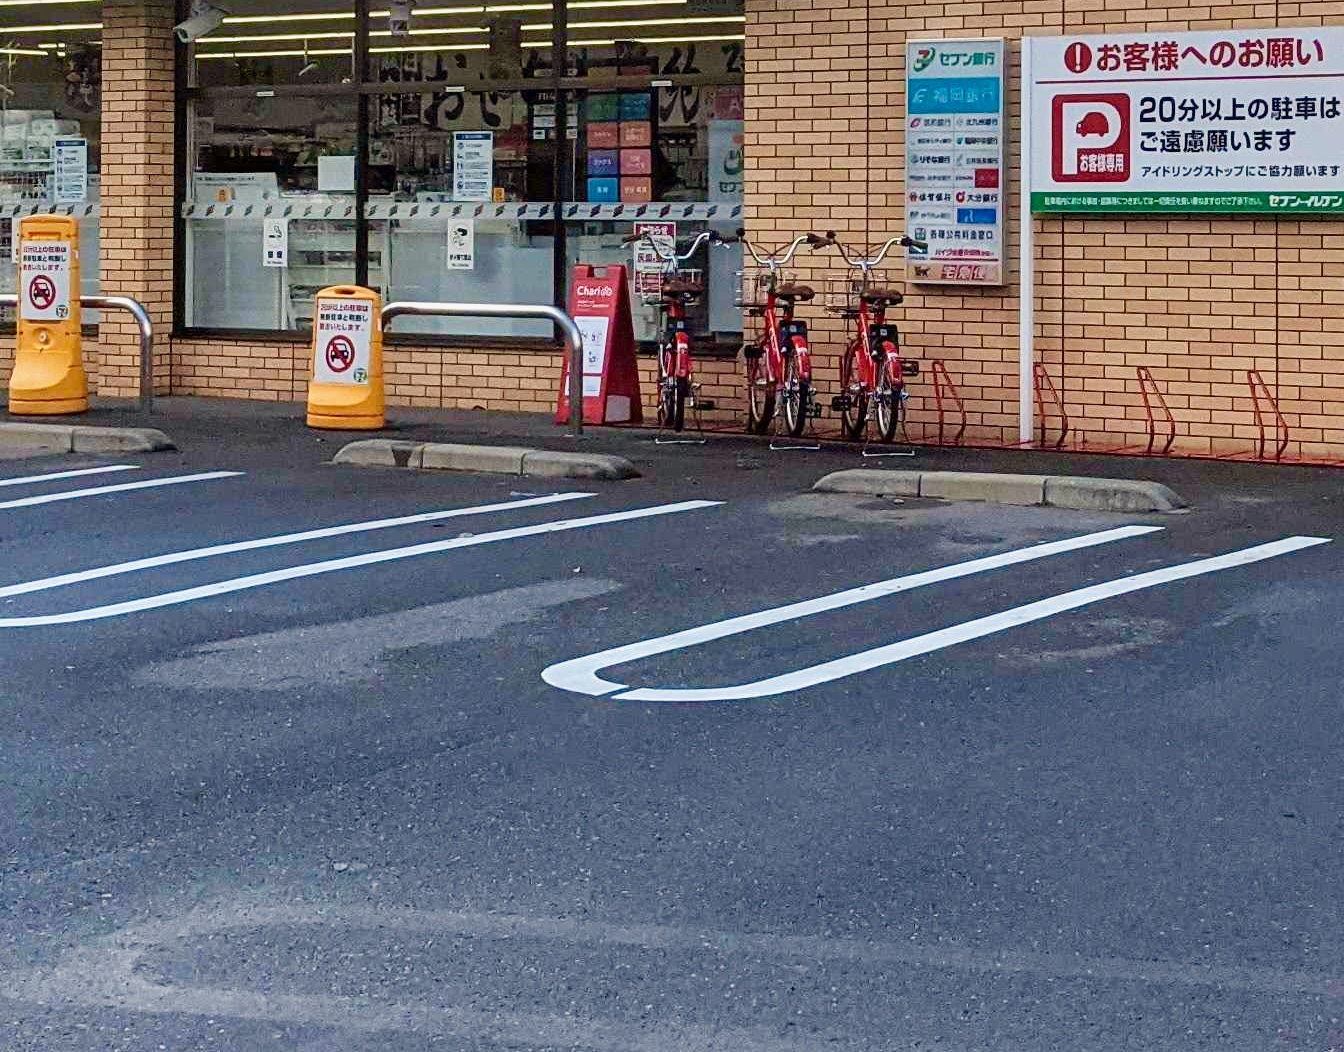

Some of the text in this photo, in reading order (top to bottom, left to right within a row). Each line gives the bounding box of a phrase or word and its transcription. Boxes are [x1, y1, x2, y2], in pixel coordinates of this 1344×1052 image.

[939, 52, 995, 66] セブン銀行
[1096, 38, 1324, 71] お客様へのお願い
[1139, 96, 1340, 123] 20分以上の駐車は
[1140, 129, 1296, 153] ご遠慮願います
[1080, 153, 1124, 173] お客様専用
[1141, 165, 1340, 178] アイドリングストップにご協力願います
